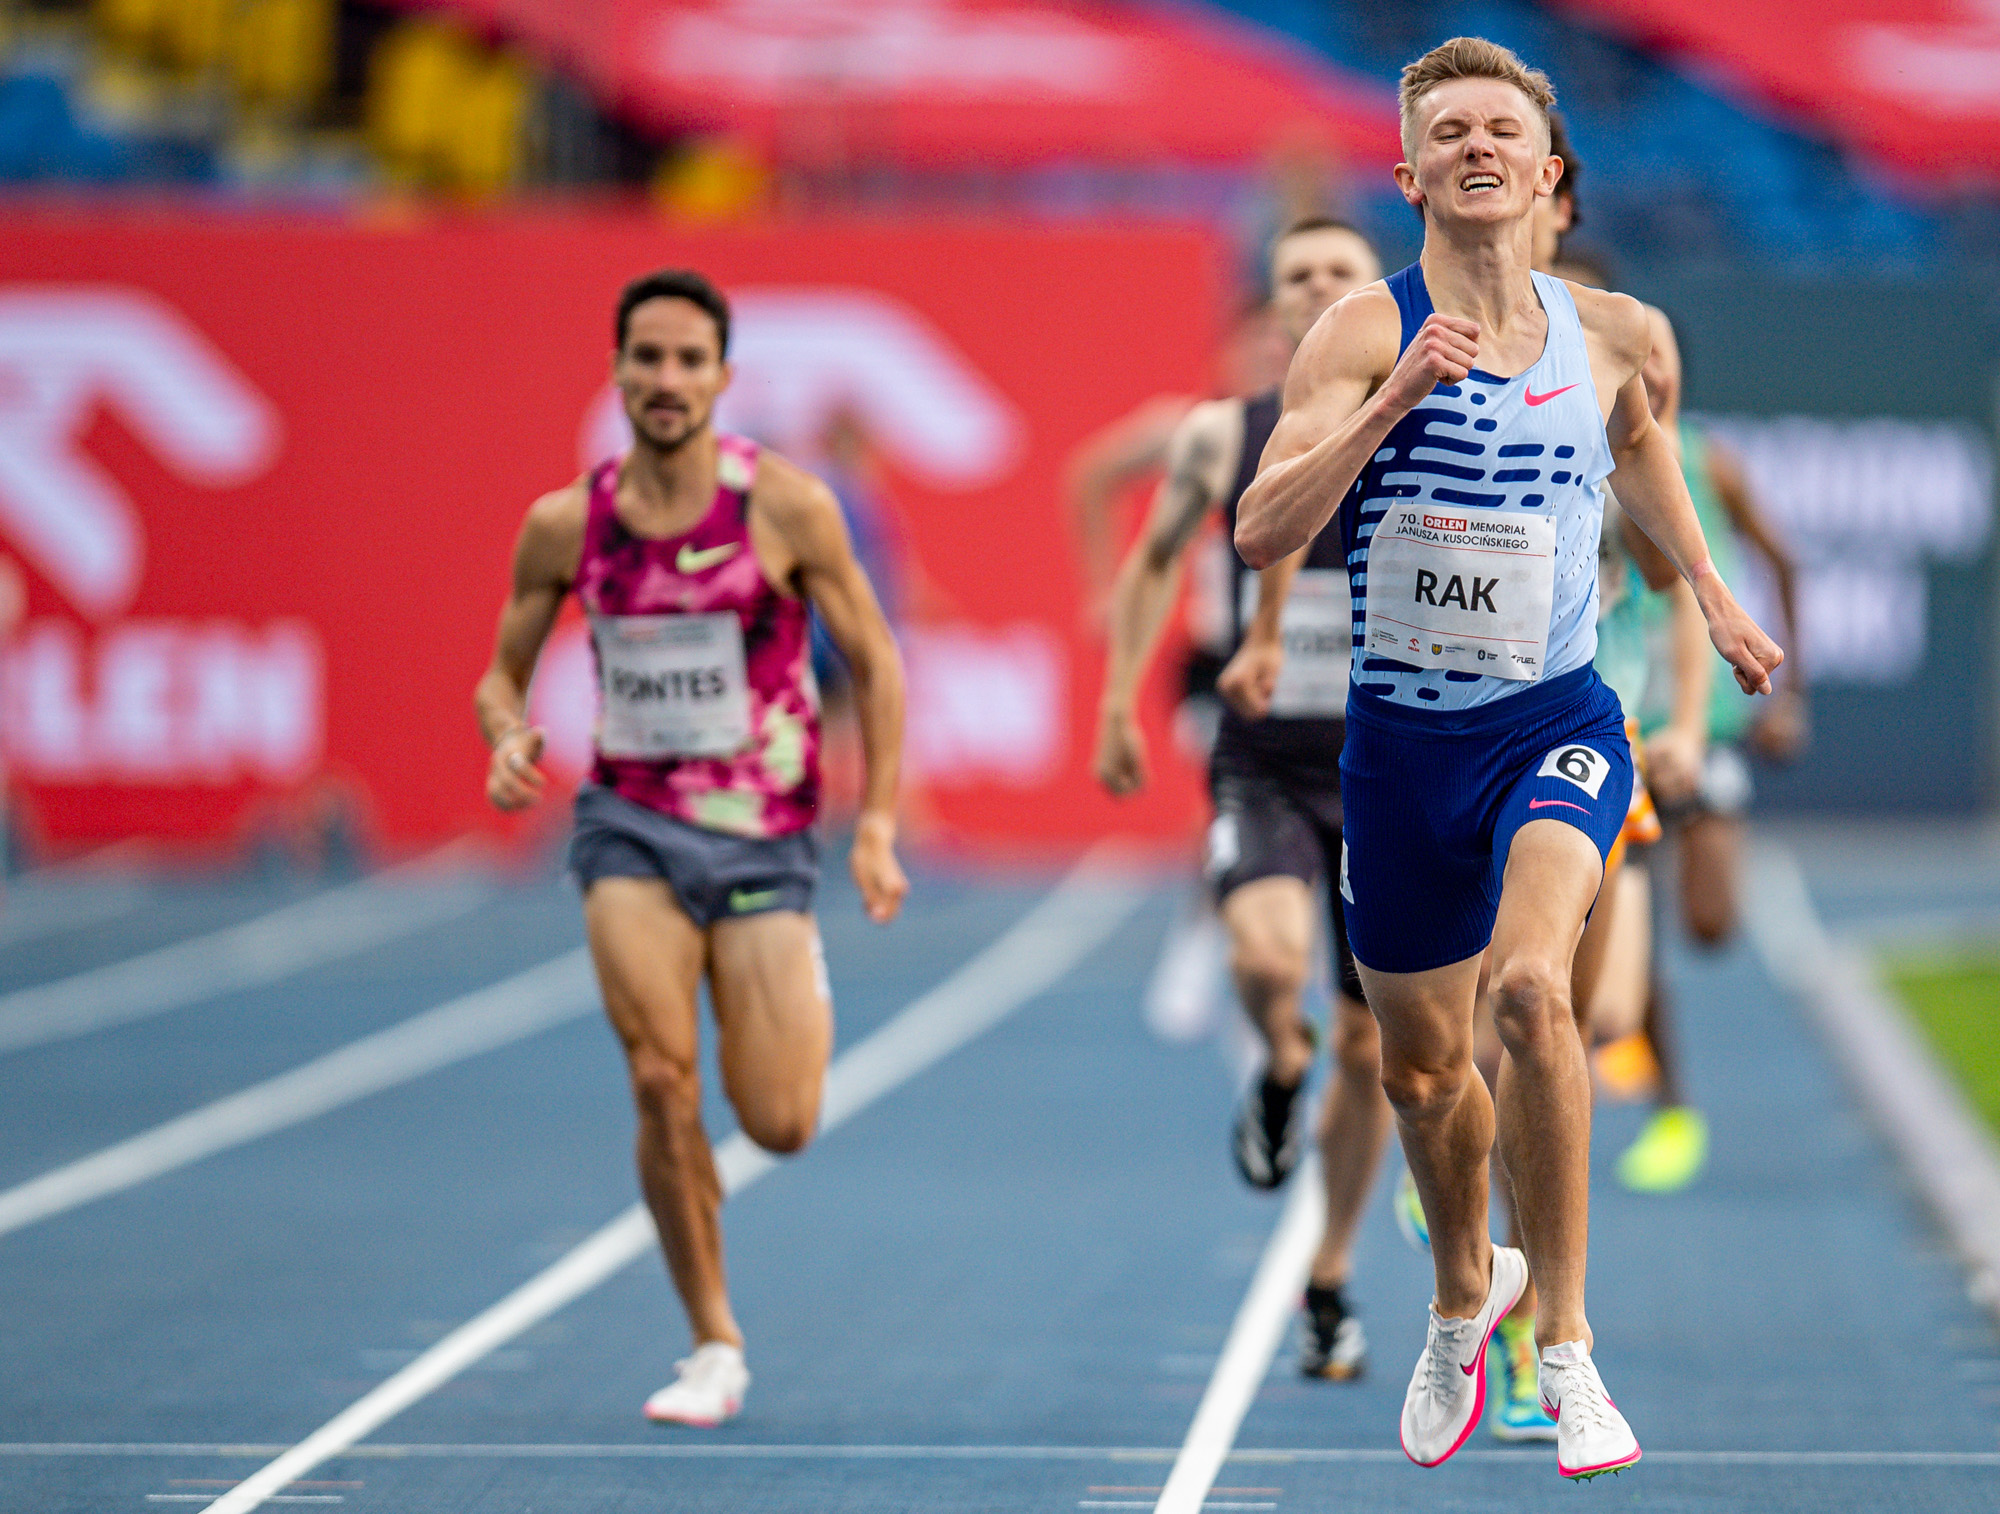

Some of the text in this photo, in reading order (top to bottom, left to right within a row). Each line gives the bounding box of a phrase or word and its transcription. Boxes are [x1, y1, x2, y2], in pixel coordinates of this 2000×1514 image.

[1400, 513, 1526, 535] 70. ORLEN MEMORIAŁ
[1395, 526, 1529, 549] JANUSZA KUSOCIŃSKIEGO
[1414, 568, 1500, 613] RAK
[1516, 656, 1537, 665] FUEL
[1556, 747, 1596, 783] 6
